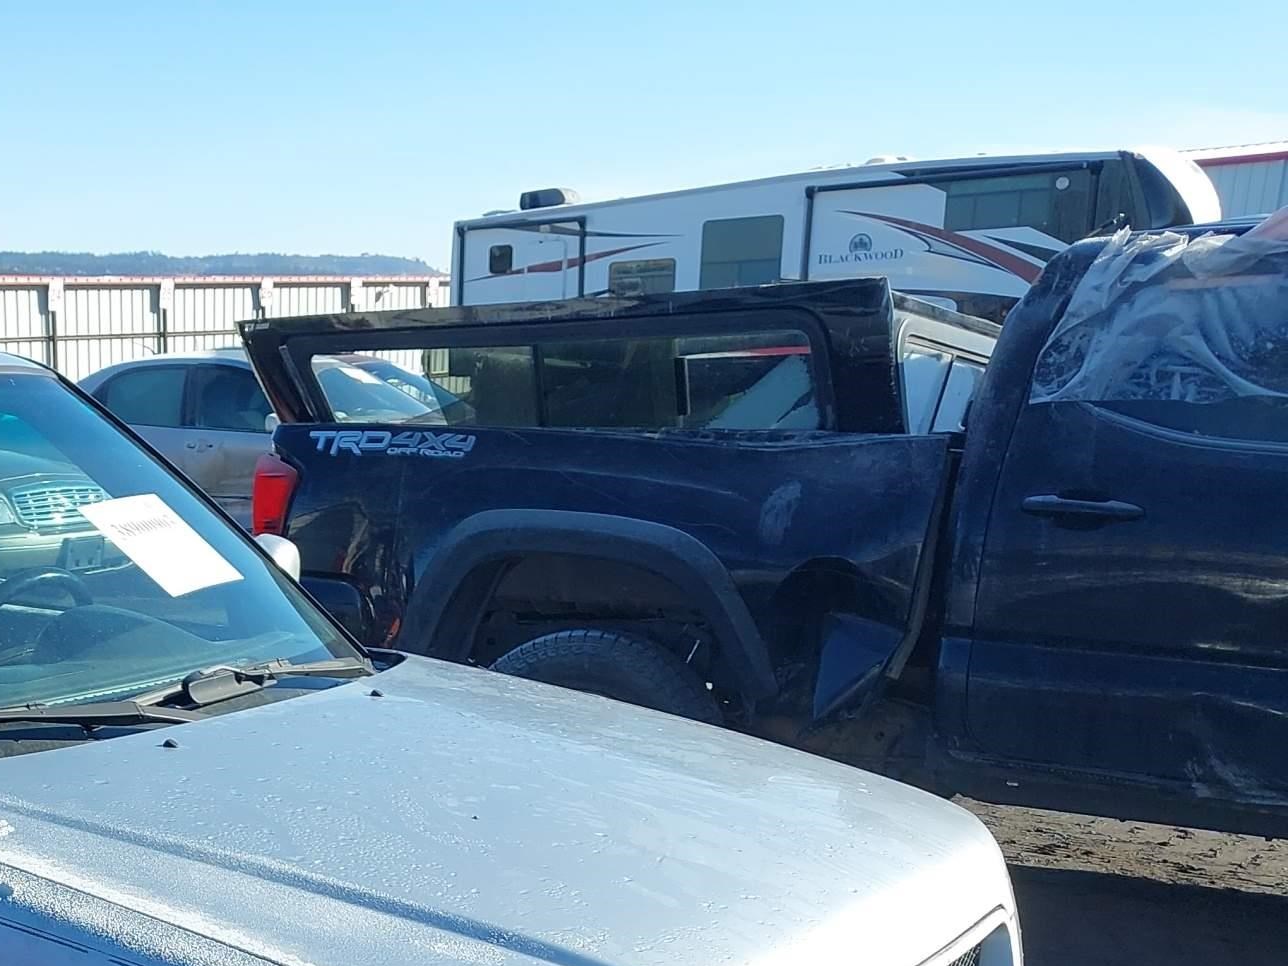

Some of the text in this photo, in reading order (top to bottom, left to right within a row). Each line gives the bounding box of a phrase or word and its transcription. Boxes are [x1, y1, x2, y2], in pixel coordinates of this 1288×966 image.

[818, 248, 904, 264] BLACKWOOD
[386, 447, 465, 458] OFF ROAD
